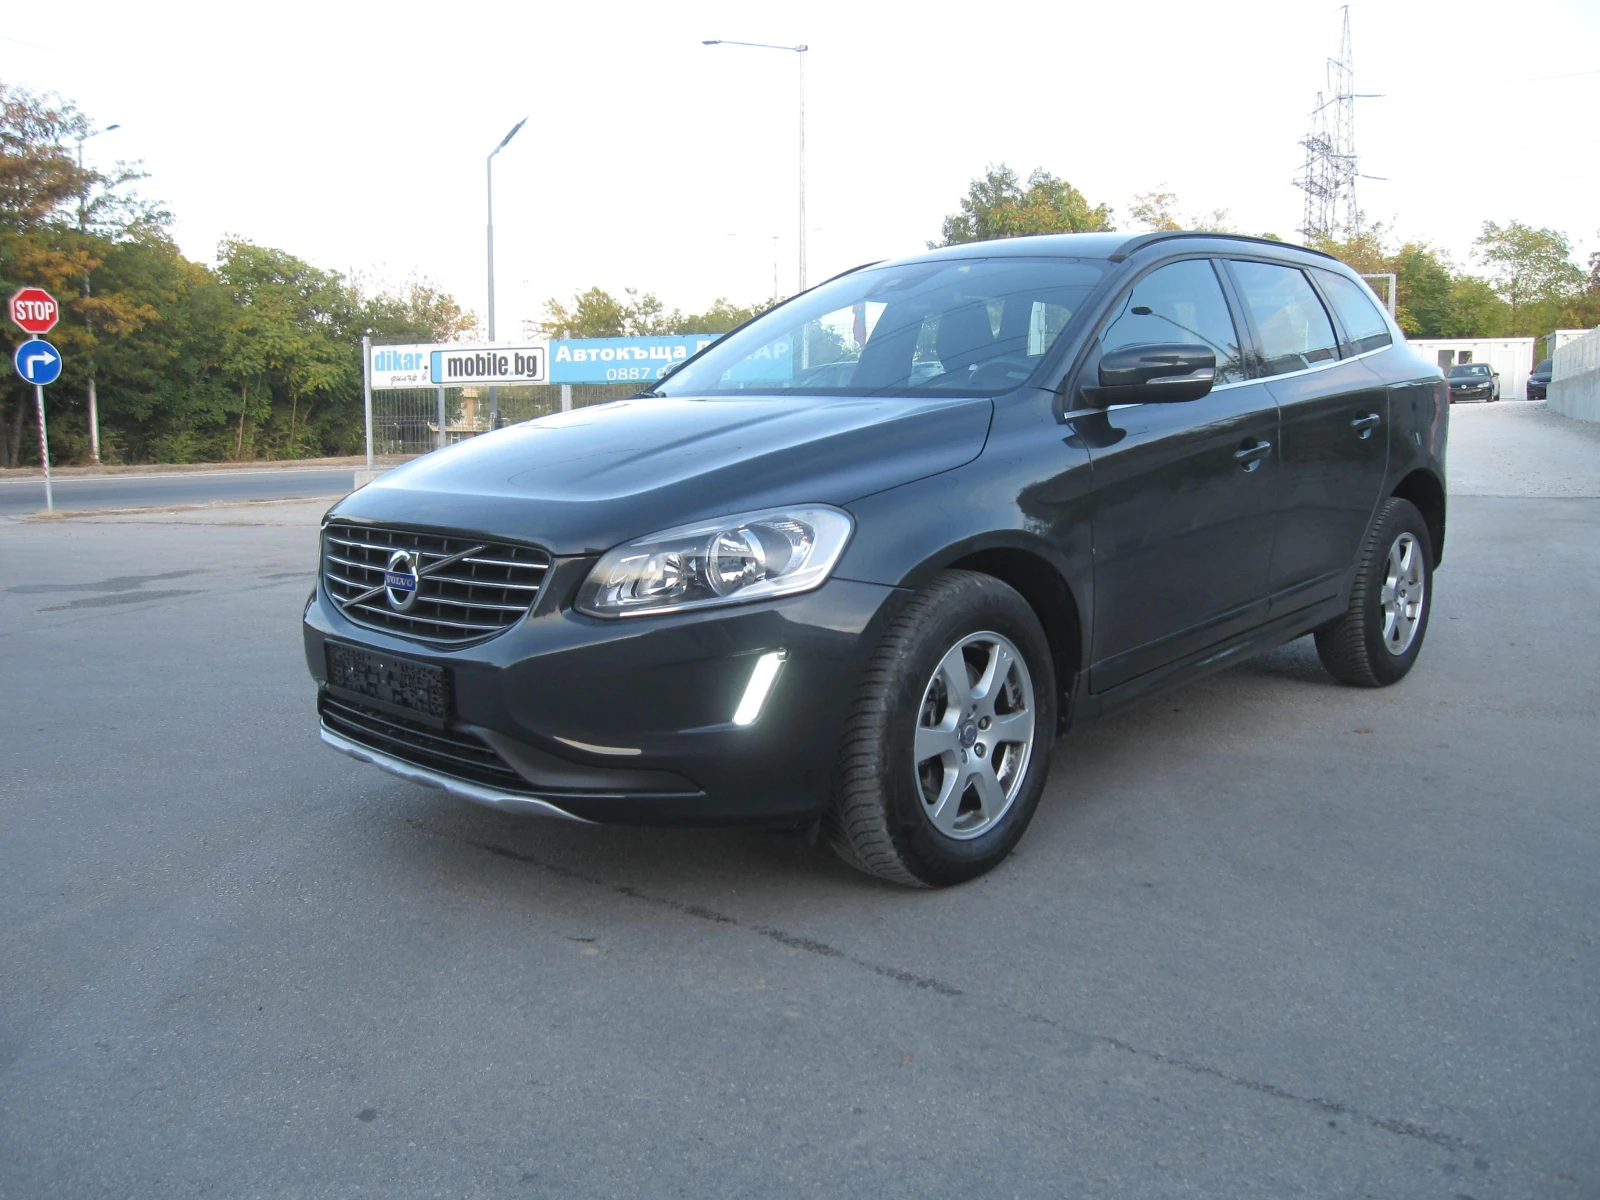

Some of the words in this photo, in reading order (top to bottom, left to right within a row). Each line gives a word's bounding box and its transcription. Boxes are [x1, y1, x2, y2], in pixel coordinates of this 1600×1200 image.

[17, 301, 54, 320] STOP
[555, 345, 687, 362] Автокъща
[447, 352, 537, 377] mobile.bg
[606, 367, 651, 380] 0887
[387, 575, 412, 587] VOLVO
